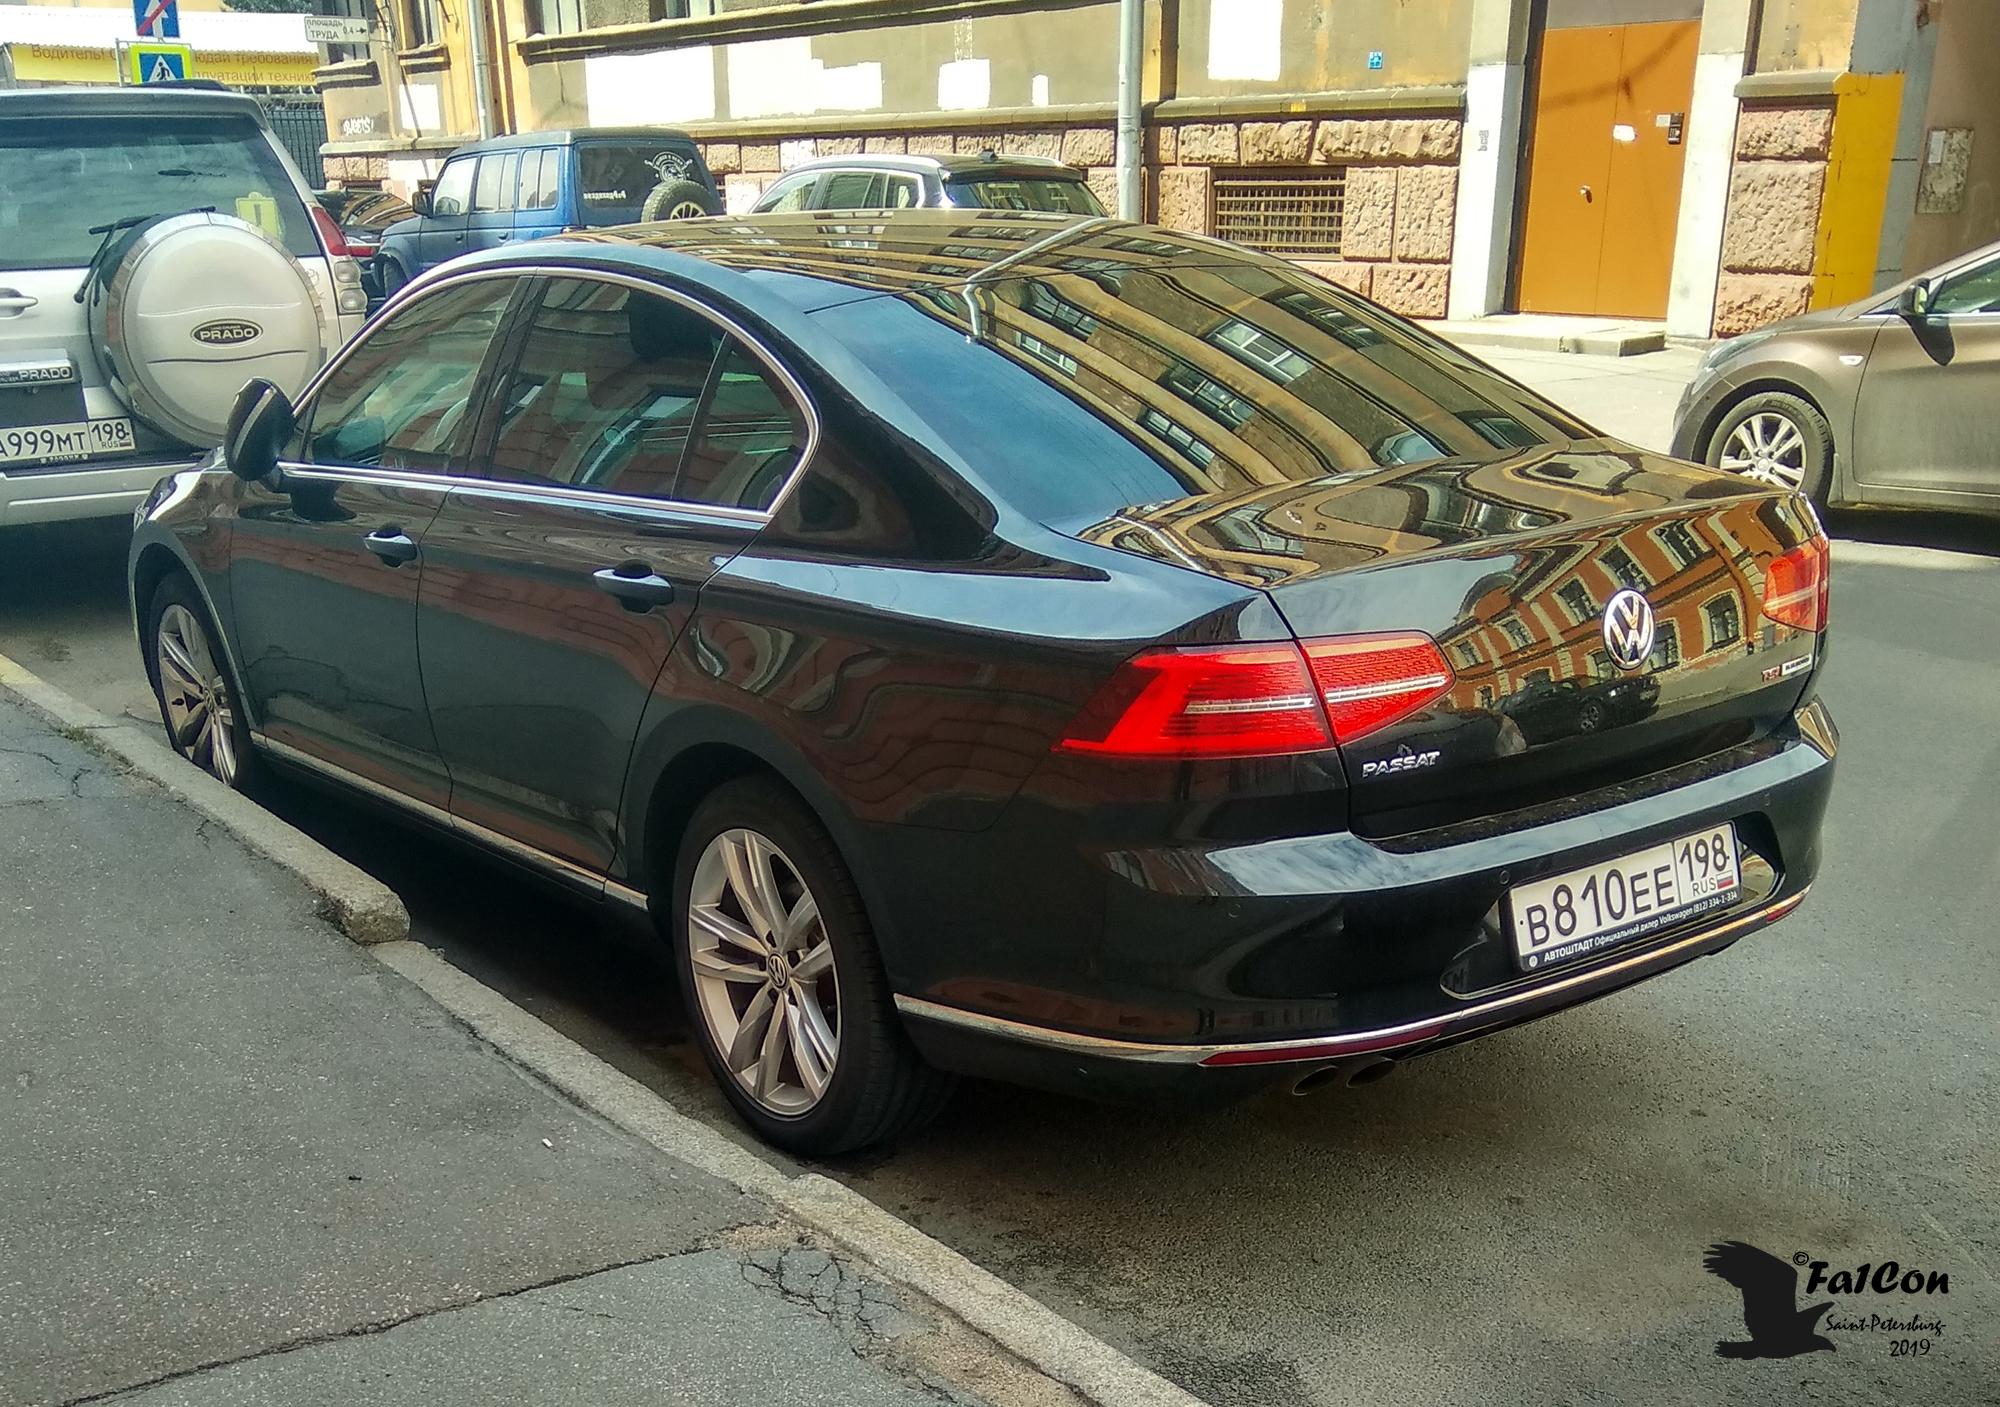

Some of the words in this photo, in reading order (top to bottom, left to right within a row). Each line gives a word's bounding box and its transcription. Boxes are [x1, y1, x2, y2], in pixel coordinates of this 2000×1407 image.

[310, 30, 339, 40] ТРУДА
[200, 328, 255, 340] PRADO
[18, 367, 71, 381] PRADO
[91, 421, 127, 442] 198
[101, 439, 119, 449] RUS
[1362, 751, 1440, 778] PASSAT
[1679, 833, 1727, 881] 198
[1692, 877, 1716, 896] RUS
[1544, 938, 1593, 962] АВТОШТАДТ
[1594, 924, 1640, 946] Официальный
[1659, 906, 1693, 925] Volkswagen
